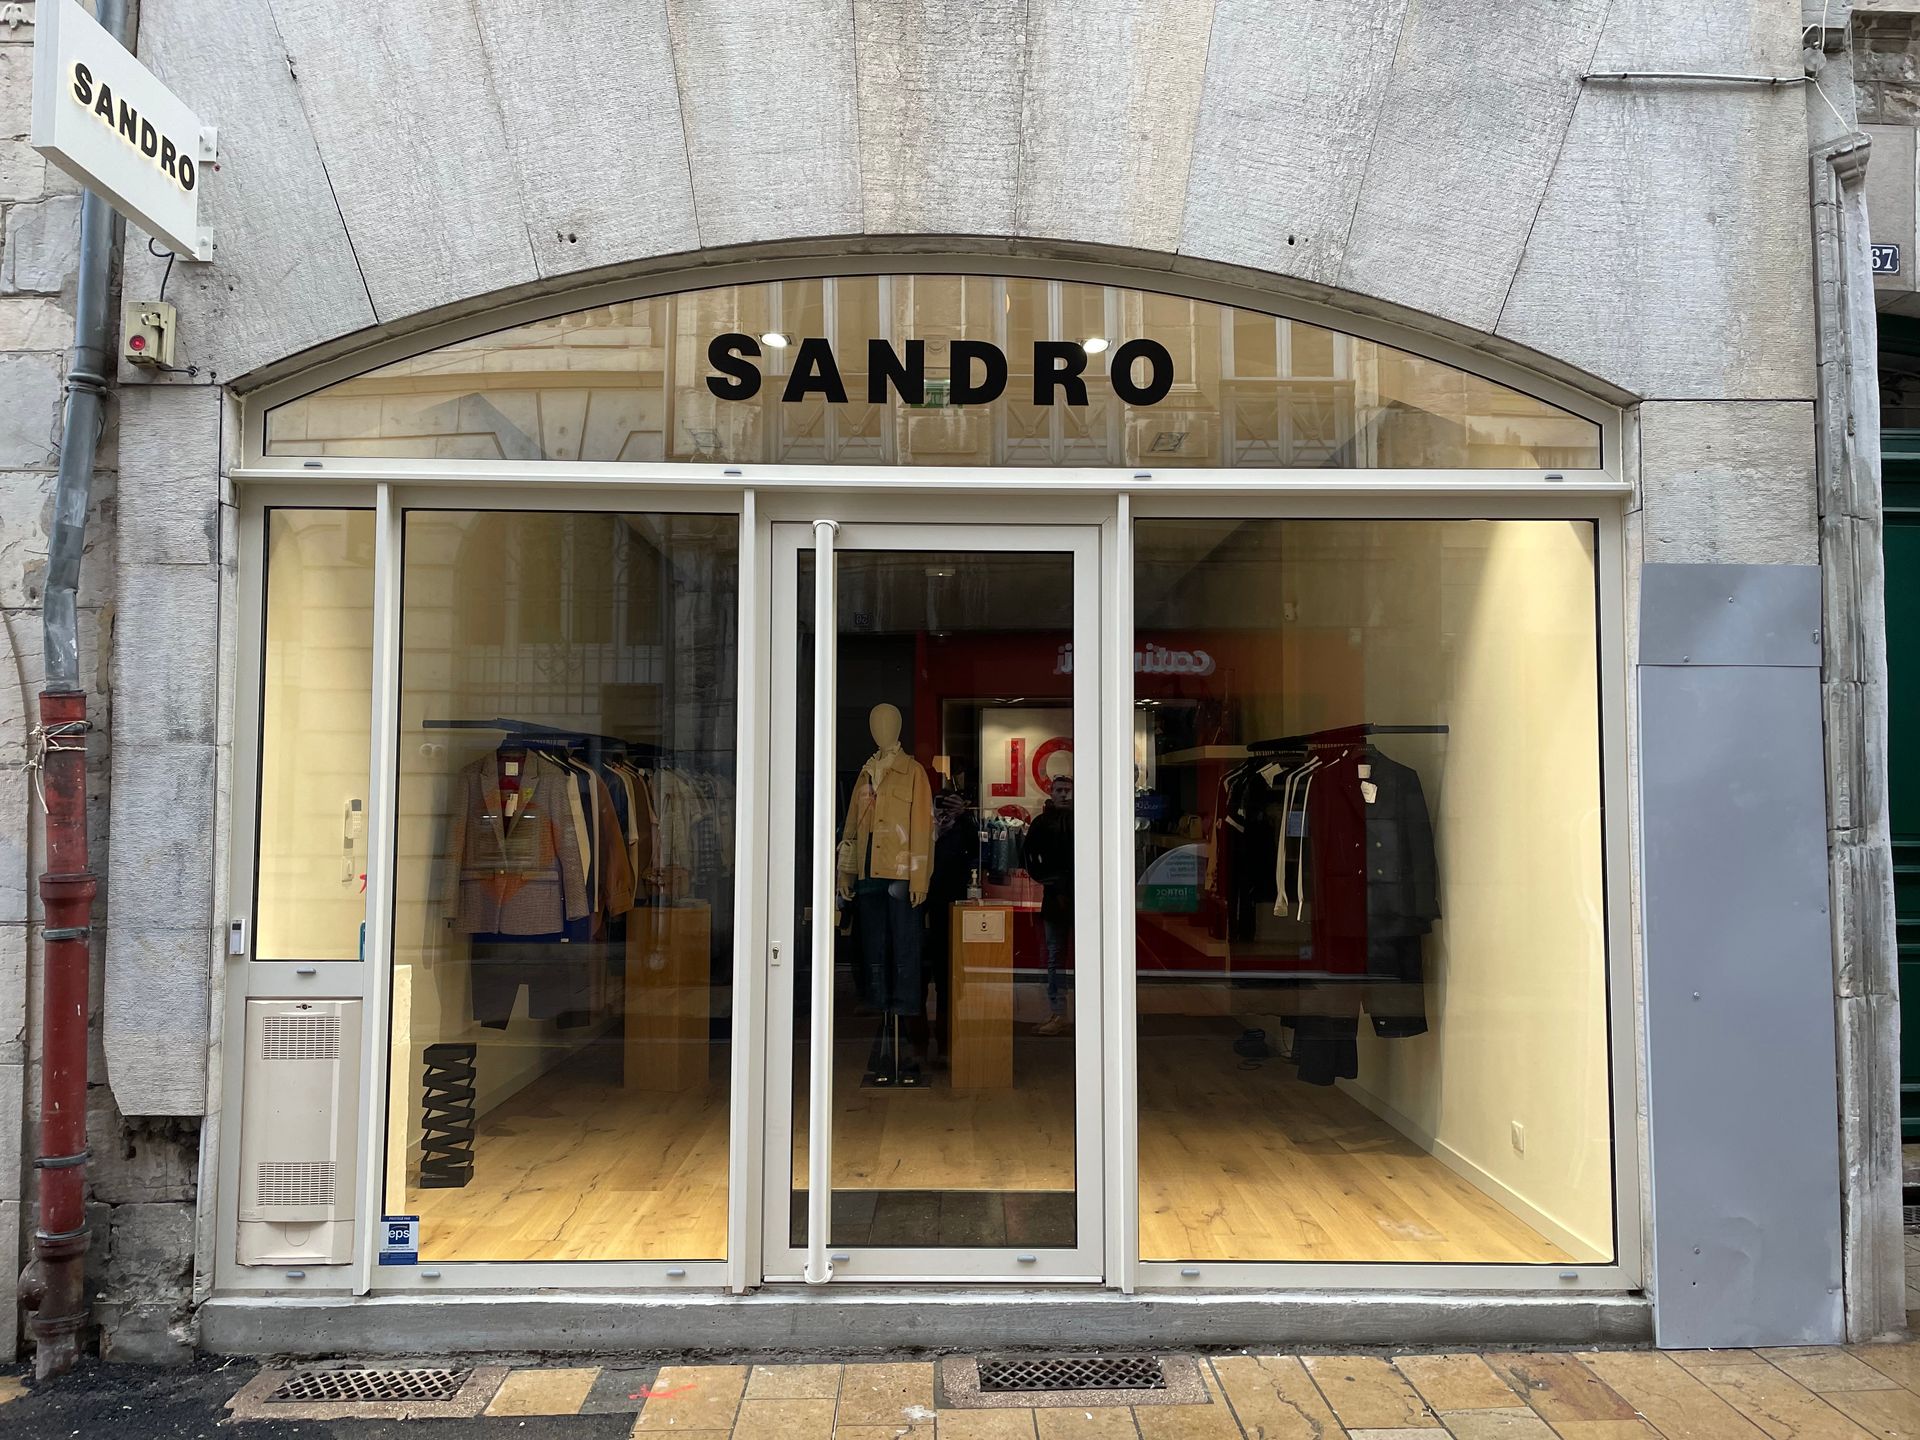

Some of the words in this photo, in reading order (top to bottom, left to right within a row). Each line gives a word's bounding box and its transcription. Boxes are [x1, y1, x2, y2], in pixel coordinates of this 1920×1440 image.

[73, 62, 195, 191] SANDRO
[1872, 248, 1893, 269] 67
[706, 333, 1174, 406] SANDRO
[389, 1230, 410, 1240] eps
